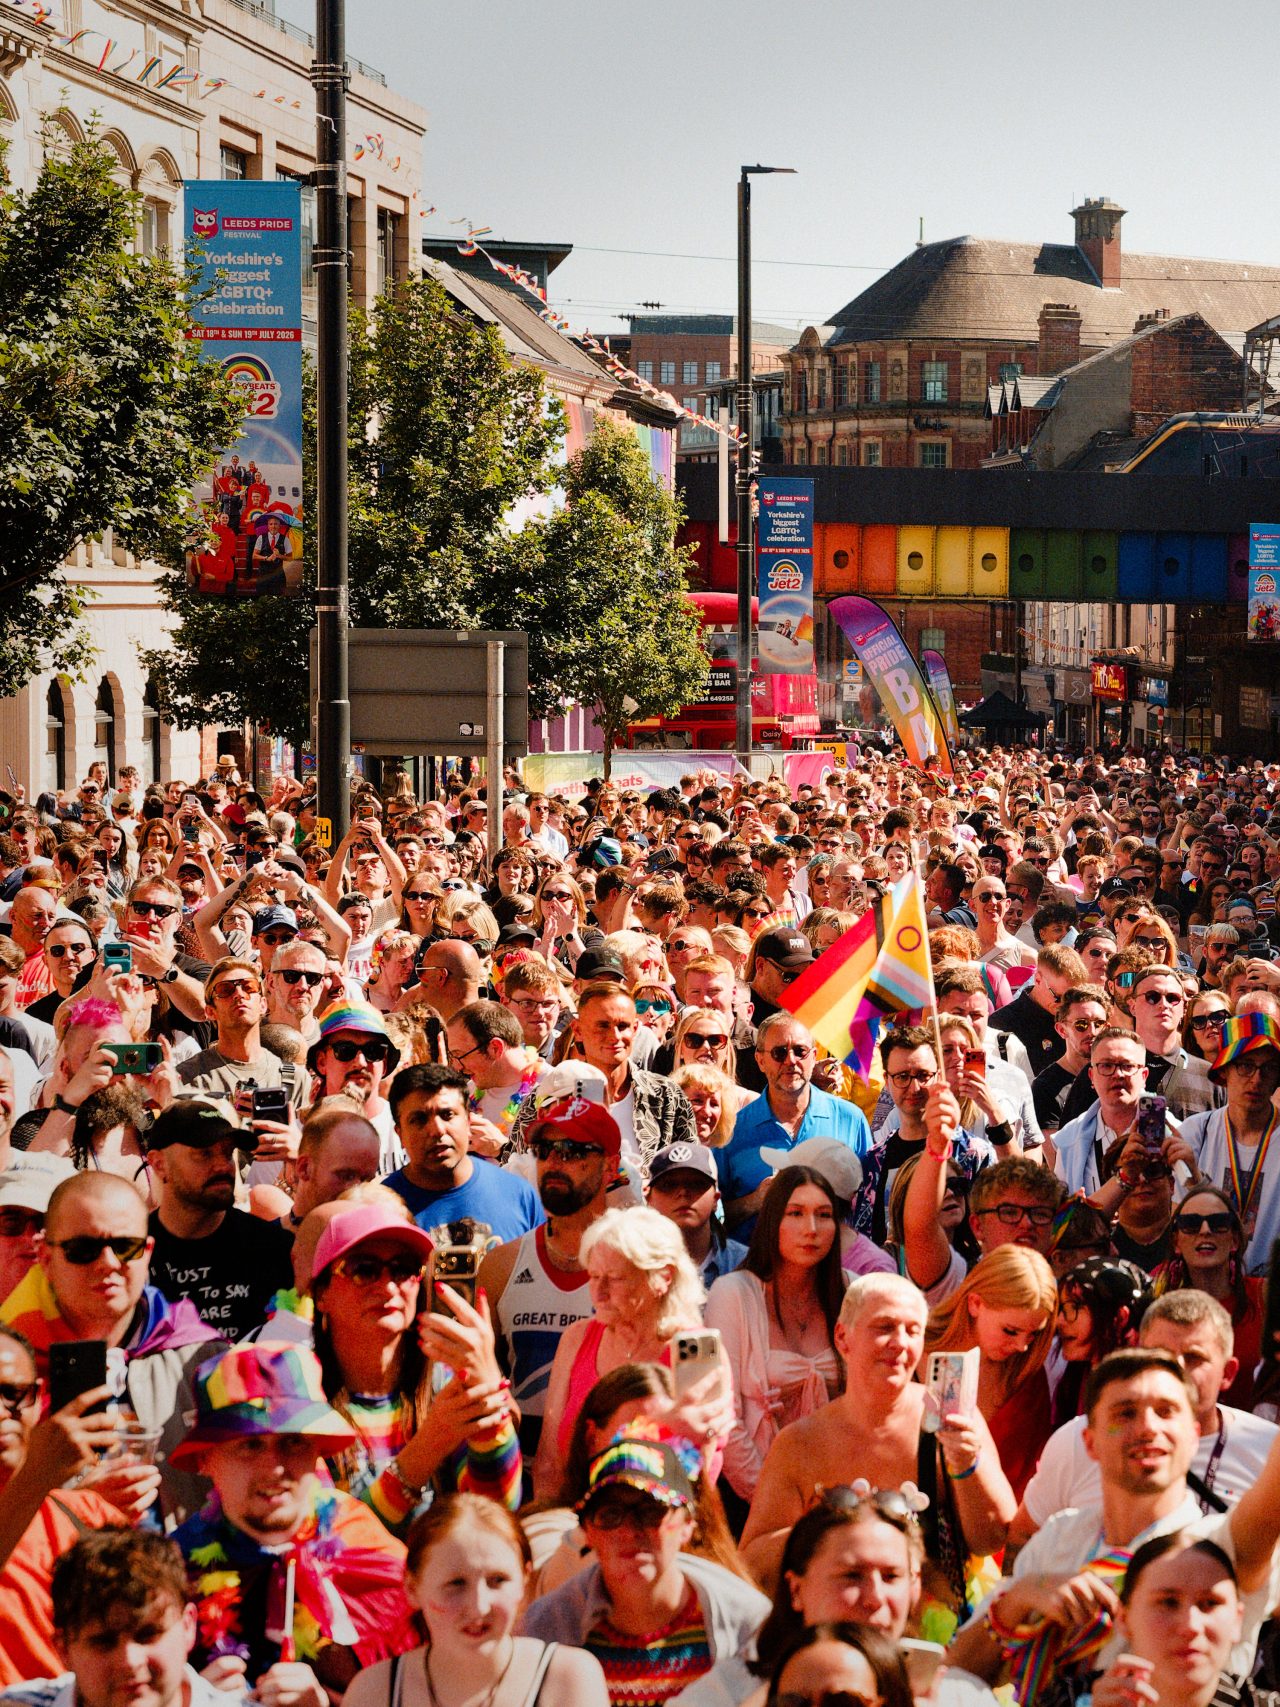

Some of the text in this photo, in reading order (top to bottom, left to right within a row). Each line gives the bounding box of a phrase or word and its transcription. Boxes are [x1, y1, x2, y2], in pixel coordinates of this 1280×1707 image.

[224, 220, 290, 229] LEEDS PRIDE
[205, 251, 283, 265] Yorkshire's
[202, 302, 284, 315] celebration
[768, 511, 805, 519] Yorkshire's
[772, 520, 799, 528] biggest
[767, 535, 805, 543] celebration
[769, 578, 800, 589] Jet2
[868, 644, 908, 677] PRIDE
[762, 730, 782, 739] Daisy
[823, 746, 837, 754] NO
[199, 1286, 220, 1299] TO
[225, 1284, 250, 1299] SAY
[200, 1305, 231, 1320] ARE
[512, 1312, 557, 1326] GREAT
